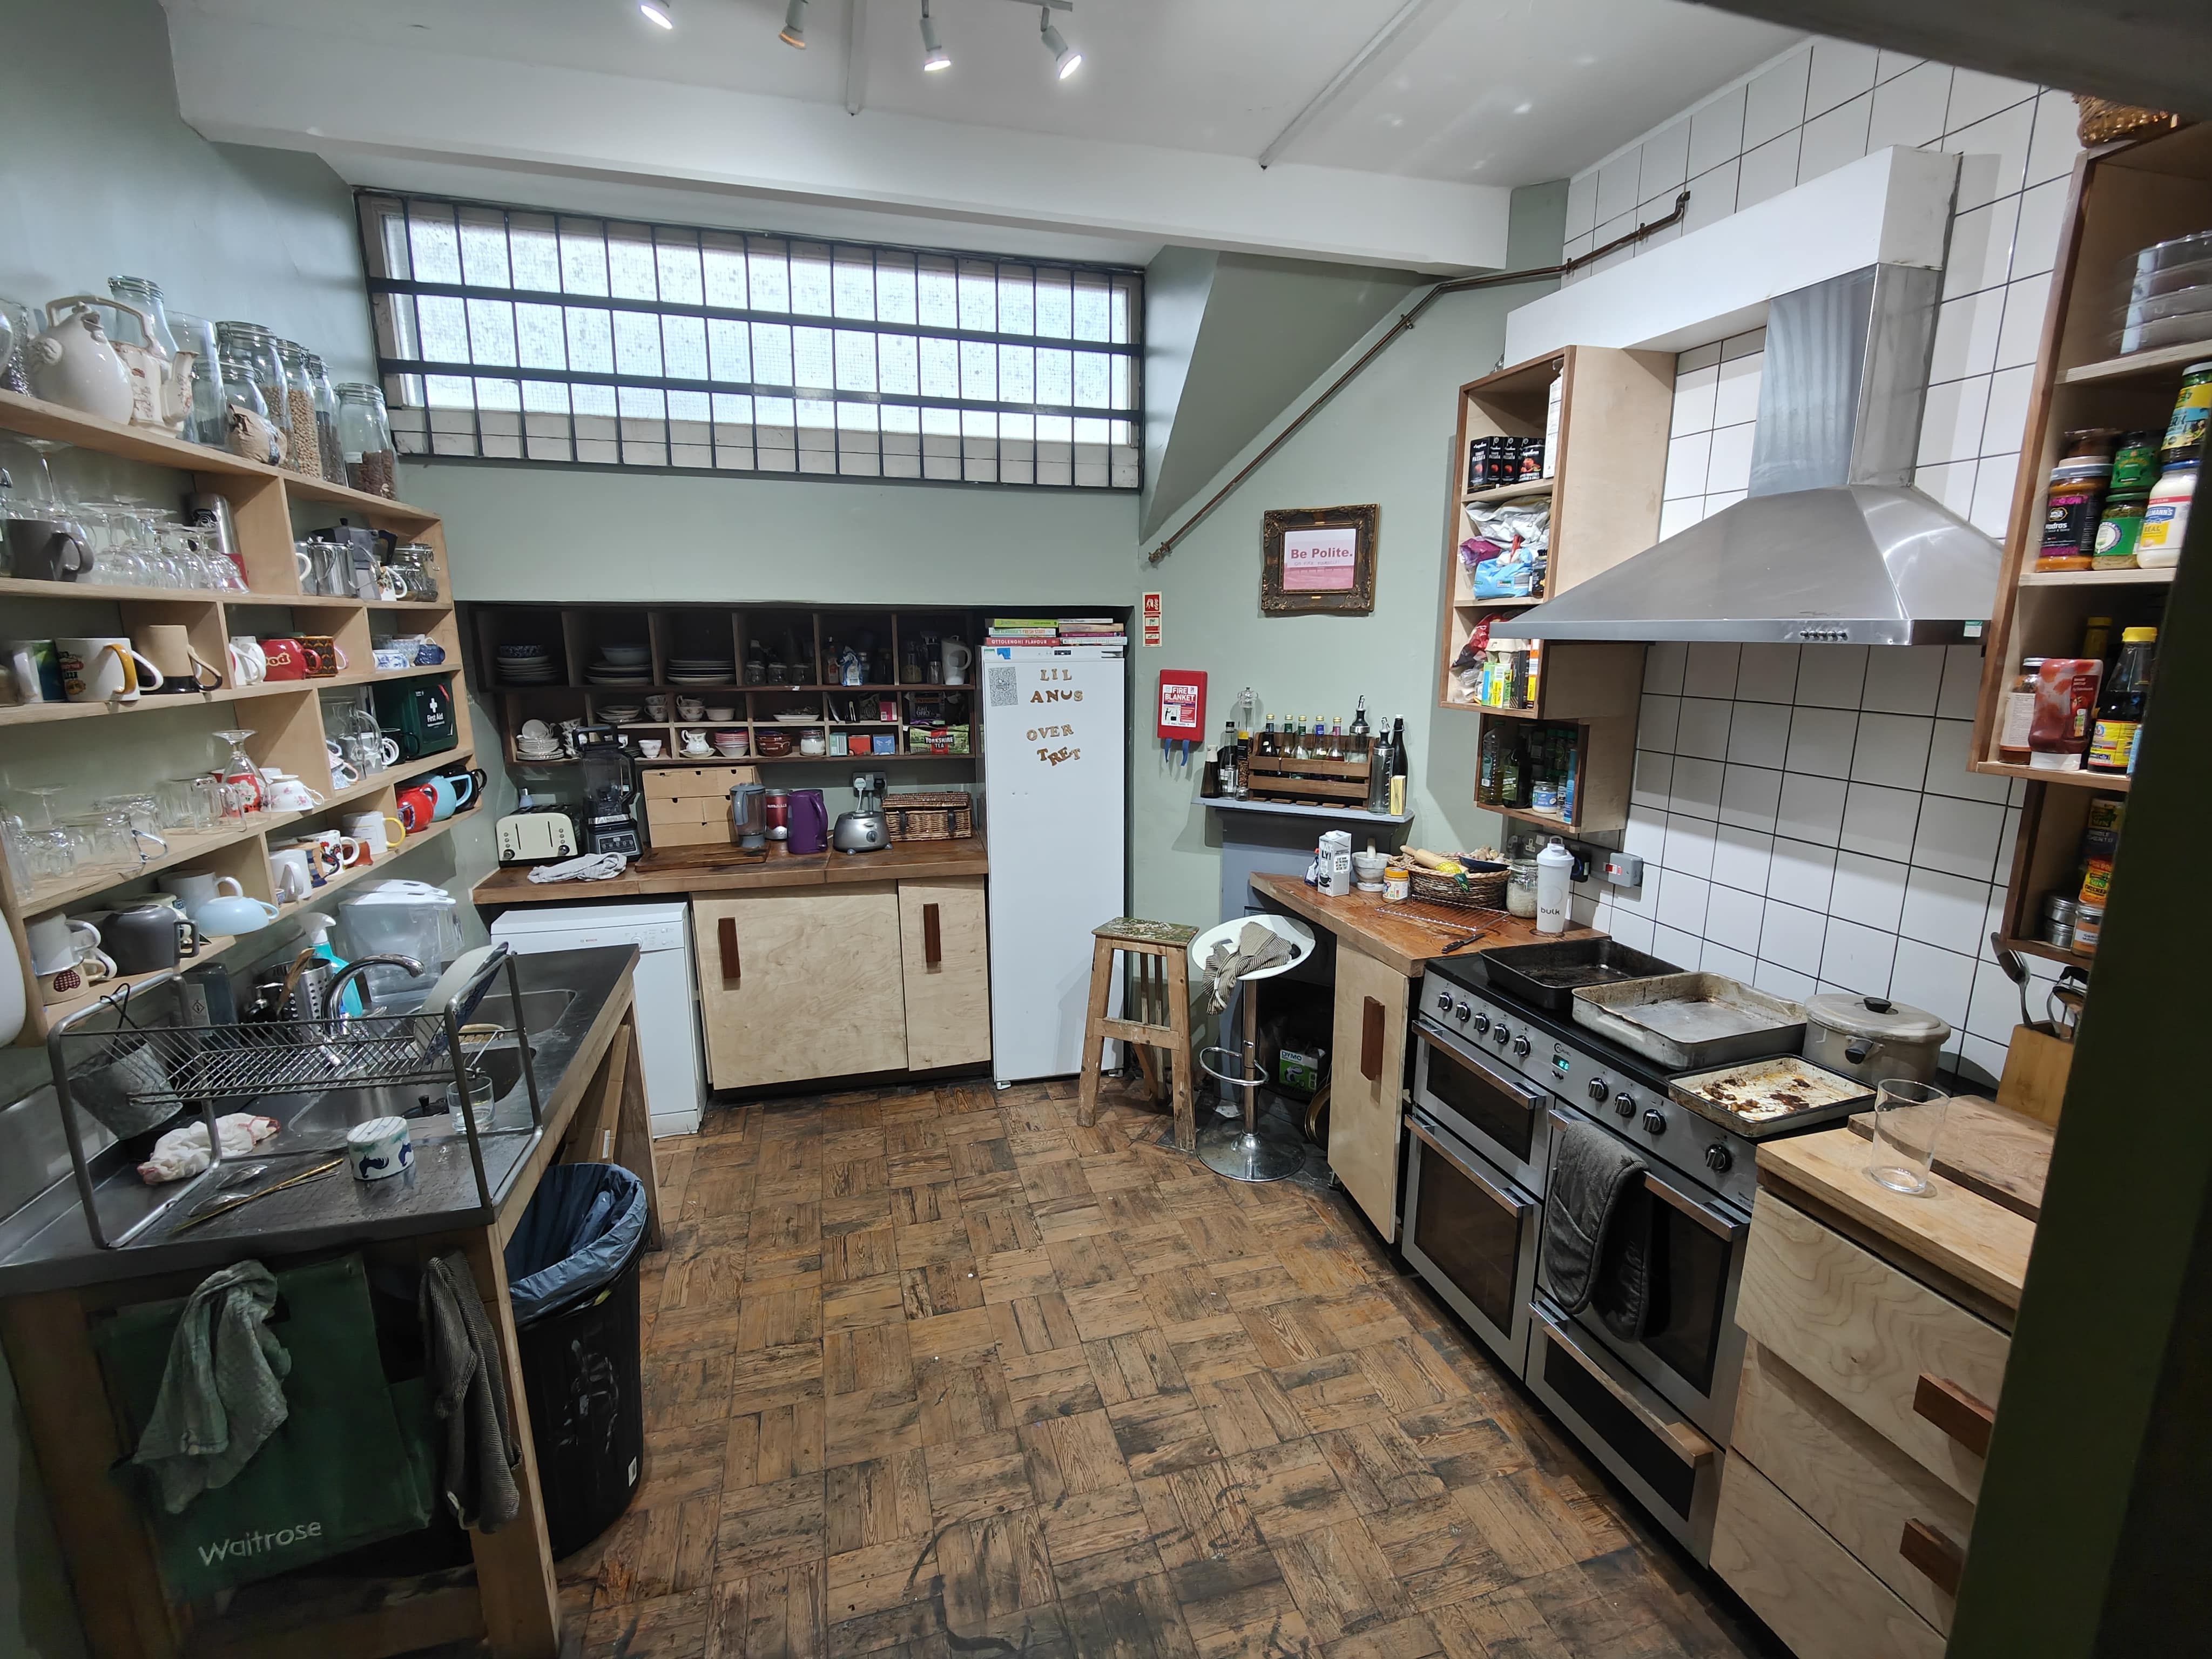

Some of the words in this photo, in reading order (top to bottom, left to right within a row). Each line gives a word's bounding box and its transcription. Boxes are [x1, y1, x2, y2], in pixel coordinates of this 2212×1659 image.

[1291, 549, 1307, 558] Be
[1312, 548, 1353, 558] Polite.
[1040, 669, 1072, 680] LIL
[1030, 690, 1083, 703] ANUS
[427, 714, 436, 722] First
[1027, 724, 1074, 741] OVER
[1282, 1051, 1302, 1061] DYMO
[198, 1522, 322, 1566] Waitrose
